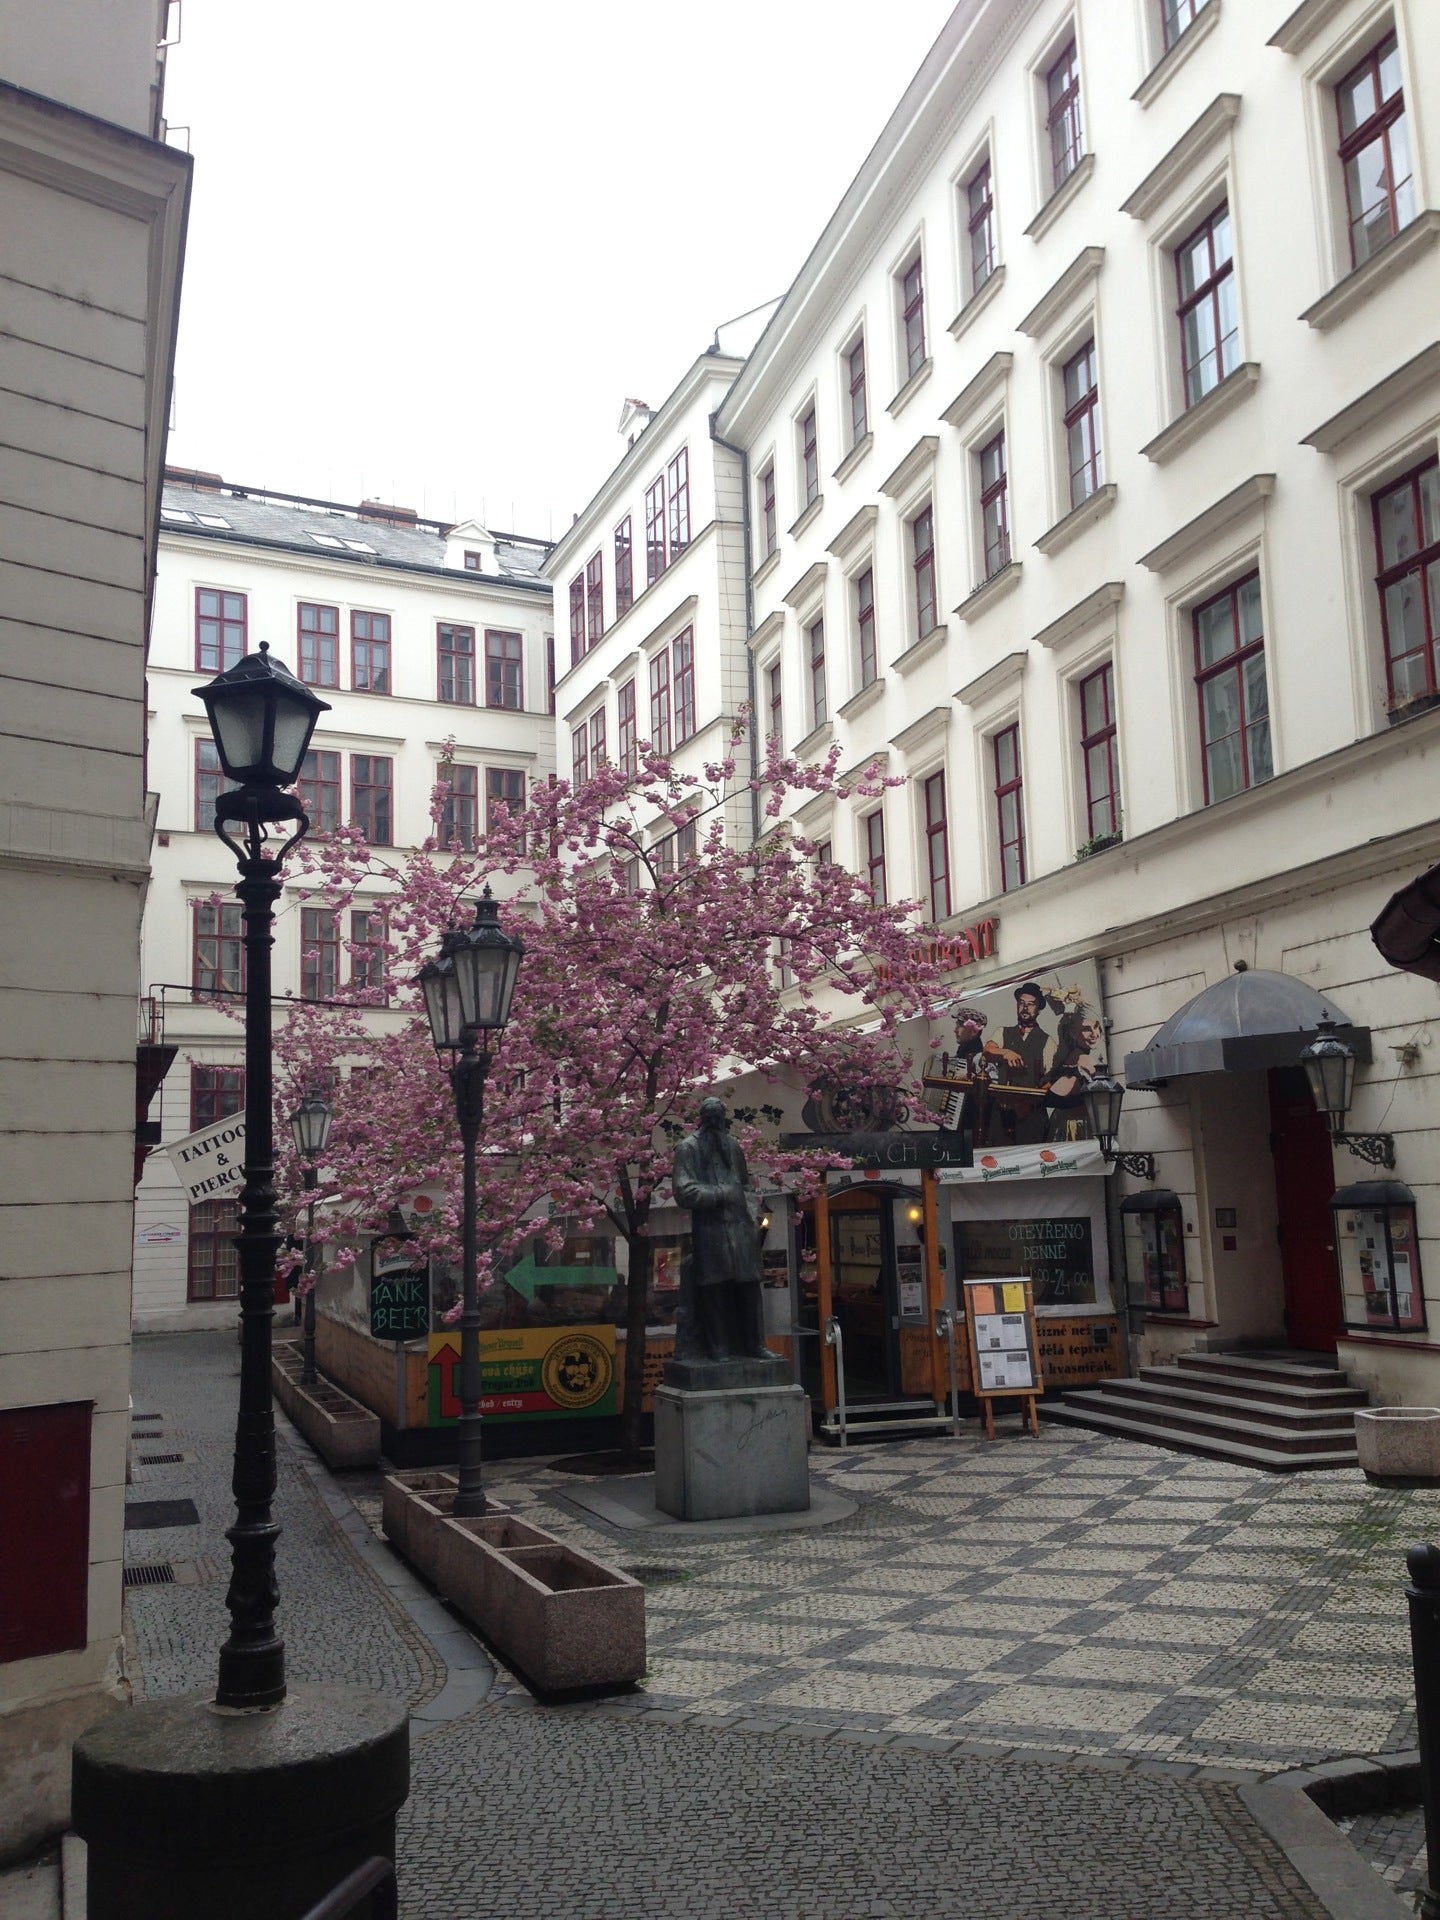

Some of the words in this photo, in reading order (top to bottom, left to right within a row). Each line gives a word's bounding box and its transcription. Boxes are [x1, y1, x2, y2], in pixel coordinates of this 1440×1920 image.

[178, 1124, 246, 1163] TATTOO
[217, 1153, 230, 1166] &
[190, 1163, 246, 1198] PIERCI
[1008, 1221, 1084, 1240] OTEVŘENO
[1023, 1241, 1067, 1260] DENNĚ
[372, 1281, 424, 1304] TANK
[374, 1306, 429, 1332] BEER
